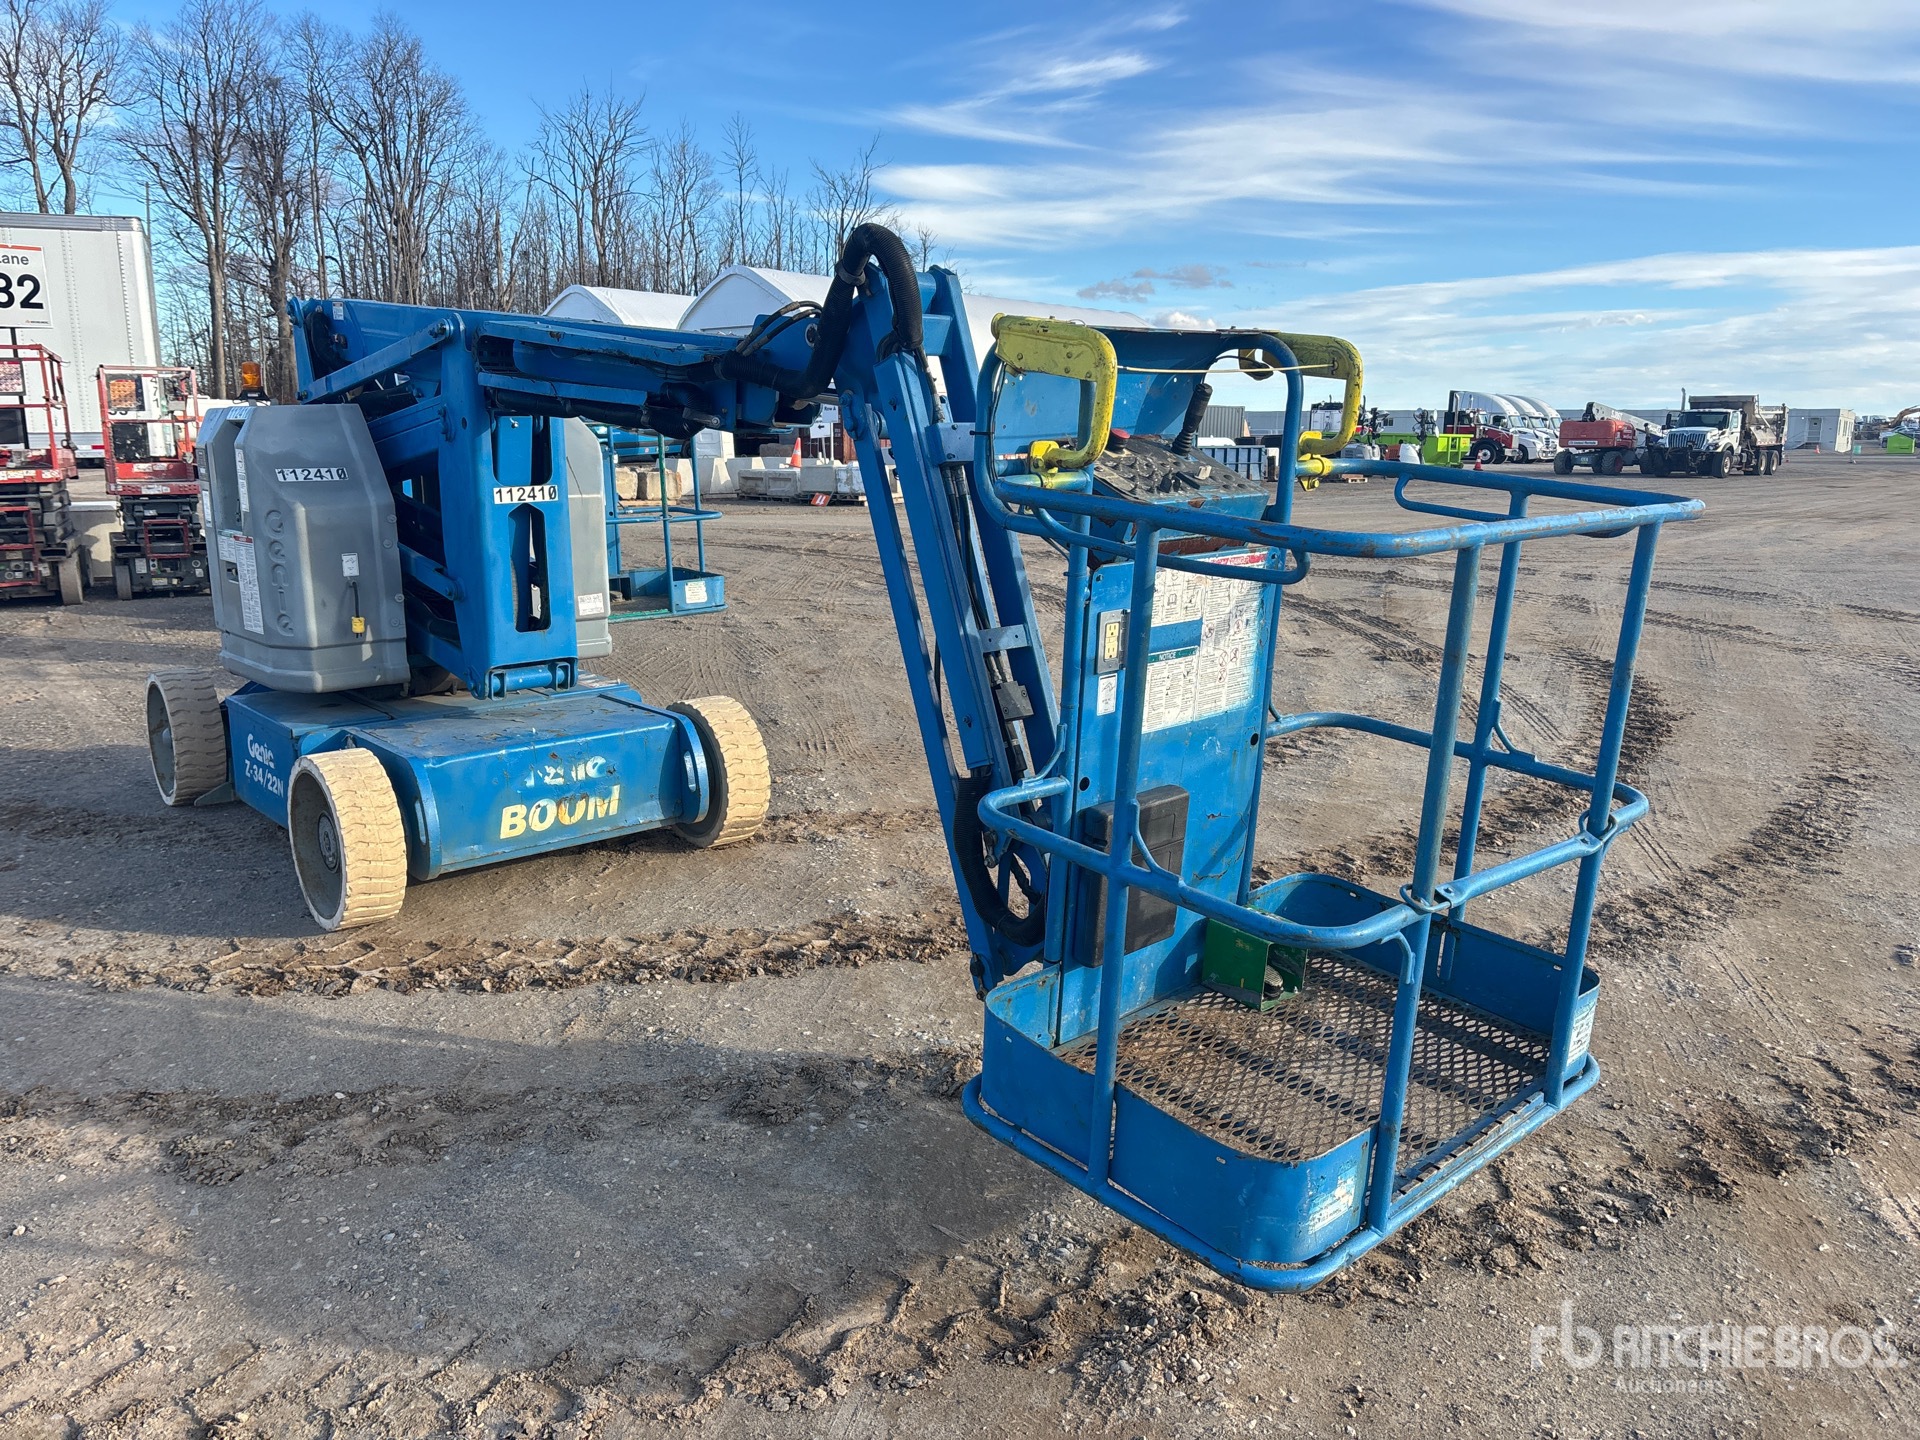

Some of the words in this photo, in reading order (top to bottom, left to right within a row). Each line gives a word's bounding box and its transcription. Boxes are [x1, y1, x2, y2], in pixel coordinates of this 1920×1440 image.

[0, 254, 30, 266] ane
[277, 468, 348, 481] 112410
[495, 486, 557, 502] 112410
[1158, 651, 1177, 661] NOTICE
[244, 758, 284, 799] Z-34/22N
[500, 784, 620, 839] BOOM
